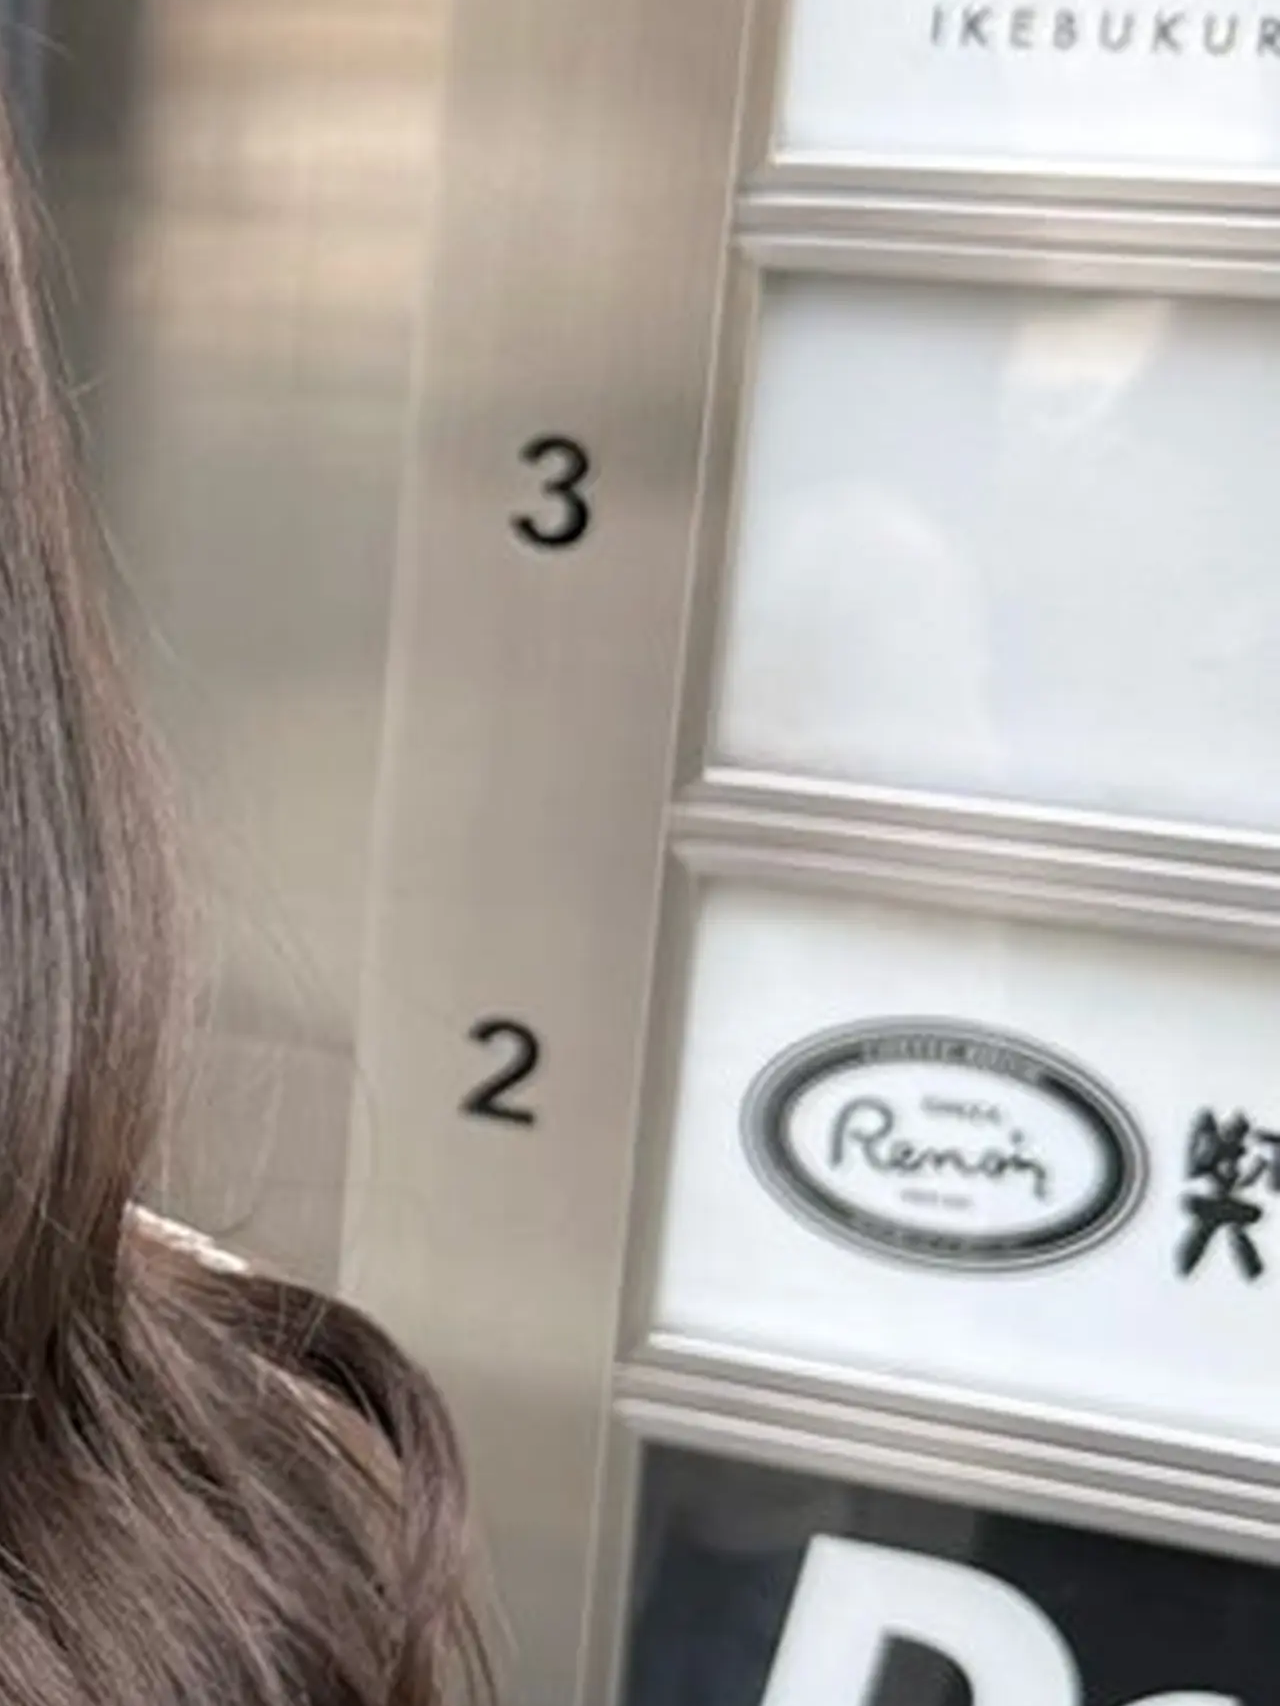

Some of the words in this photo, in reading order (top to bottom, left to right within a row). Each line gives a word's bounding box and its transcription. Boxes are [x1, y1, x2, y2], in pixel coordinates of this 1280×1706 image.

[930, 5, 1280, 57] IKEBUKUR
[510, 432, 592, 551] 3
[461, 1017, 542, 1127] 2
